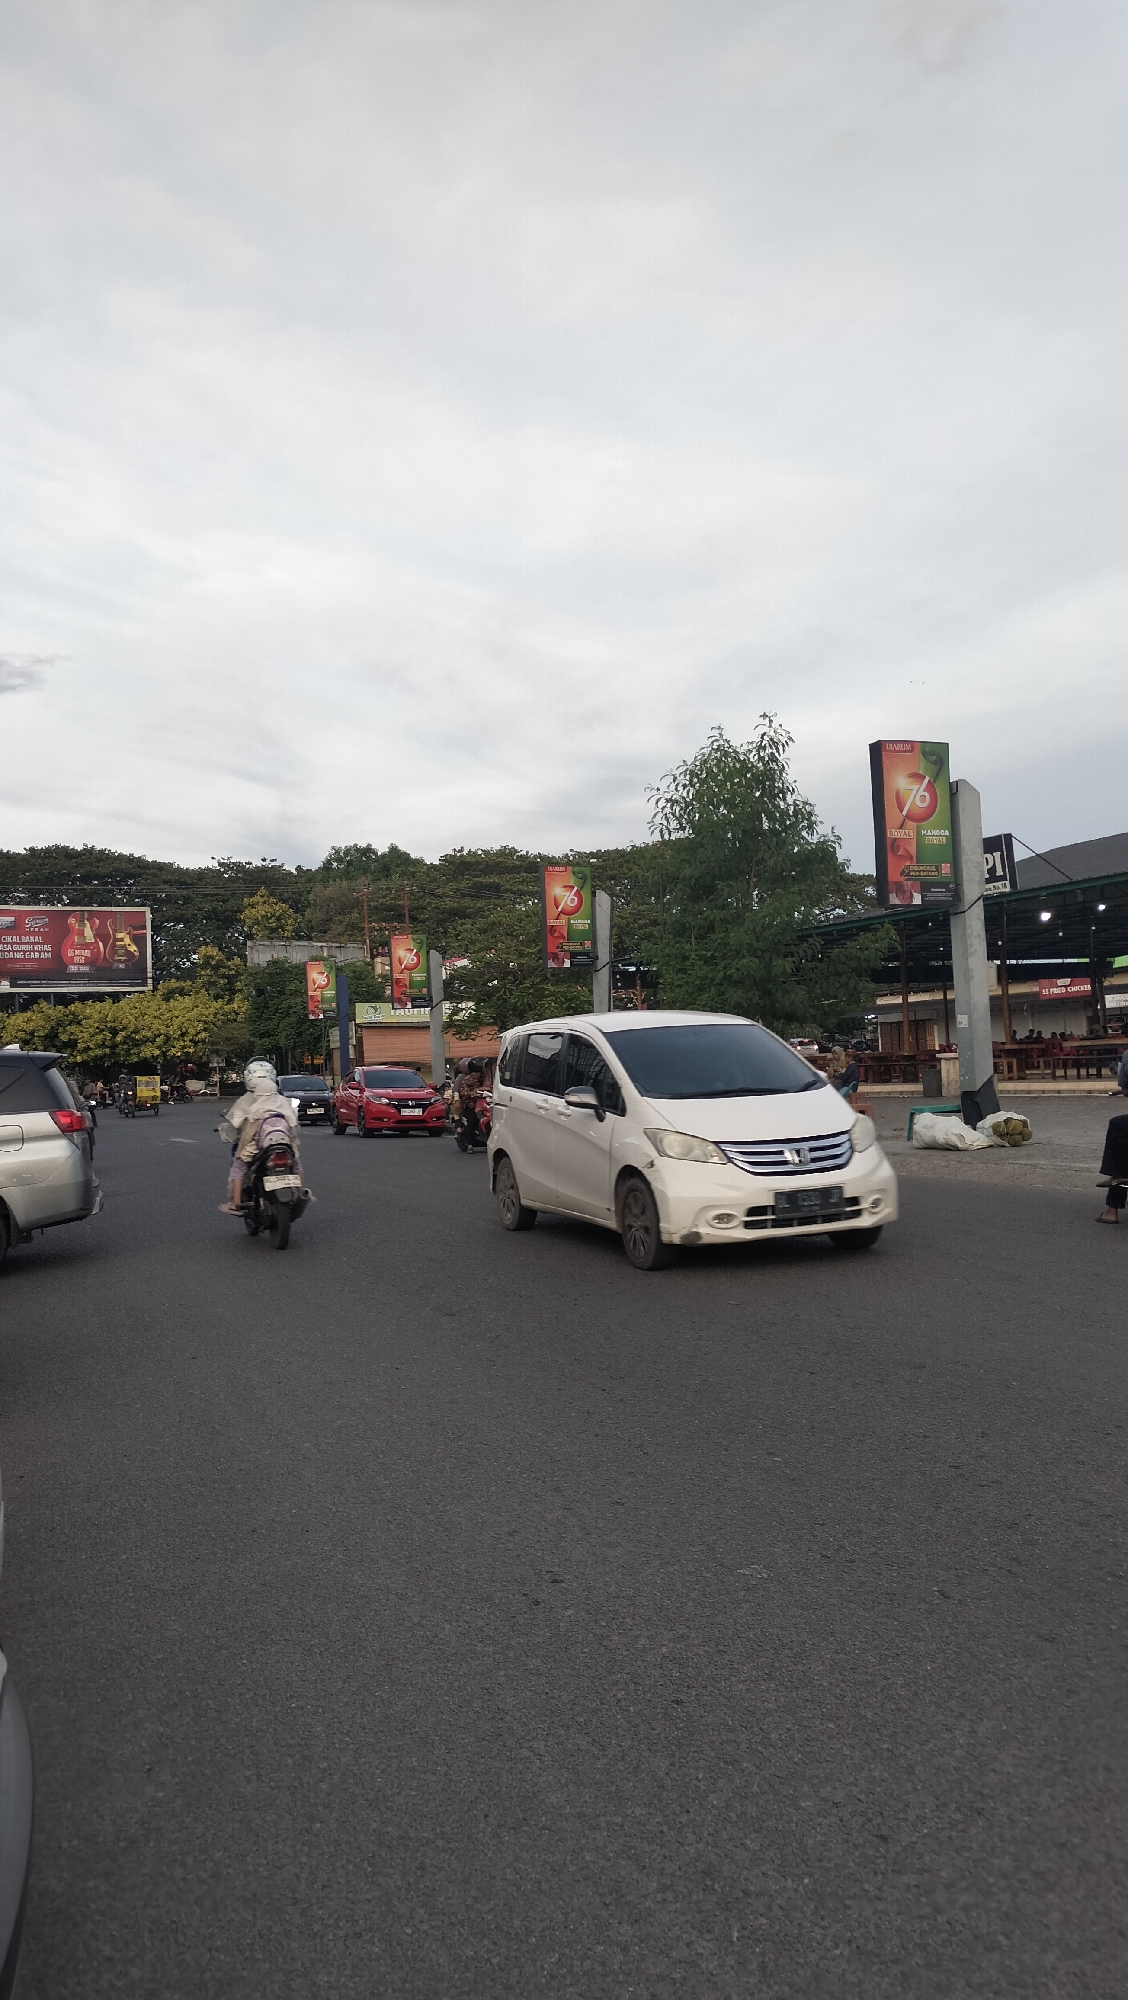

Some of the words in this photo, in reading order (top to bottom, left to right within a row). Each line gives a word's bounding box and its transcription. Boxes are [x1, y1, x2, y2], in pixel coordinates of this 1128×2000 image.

[902, 776, 930, 816] 76
[983, 851, 1004, 879] PI
[557, 886, 578, 912] 76
[401, 948, 418, 969] 76
[1050, 986, 1066, 994] FRIED
